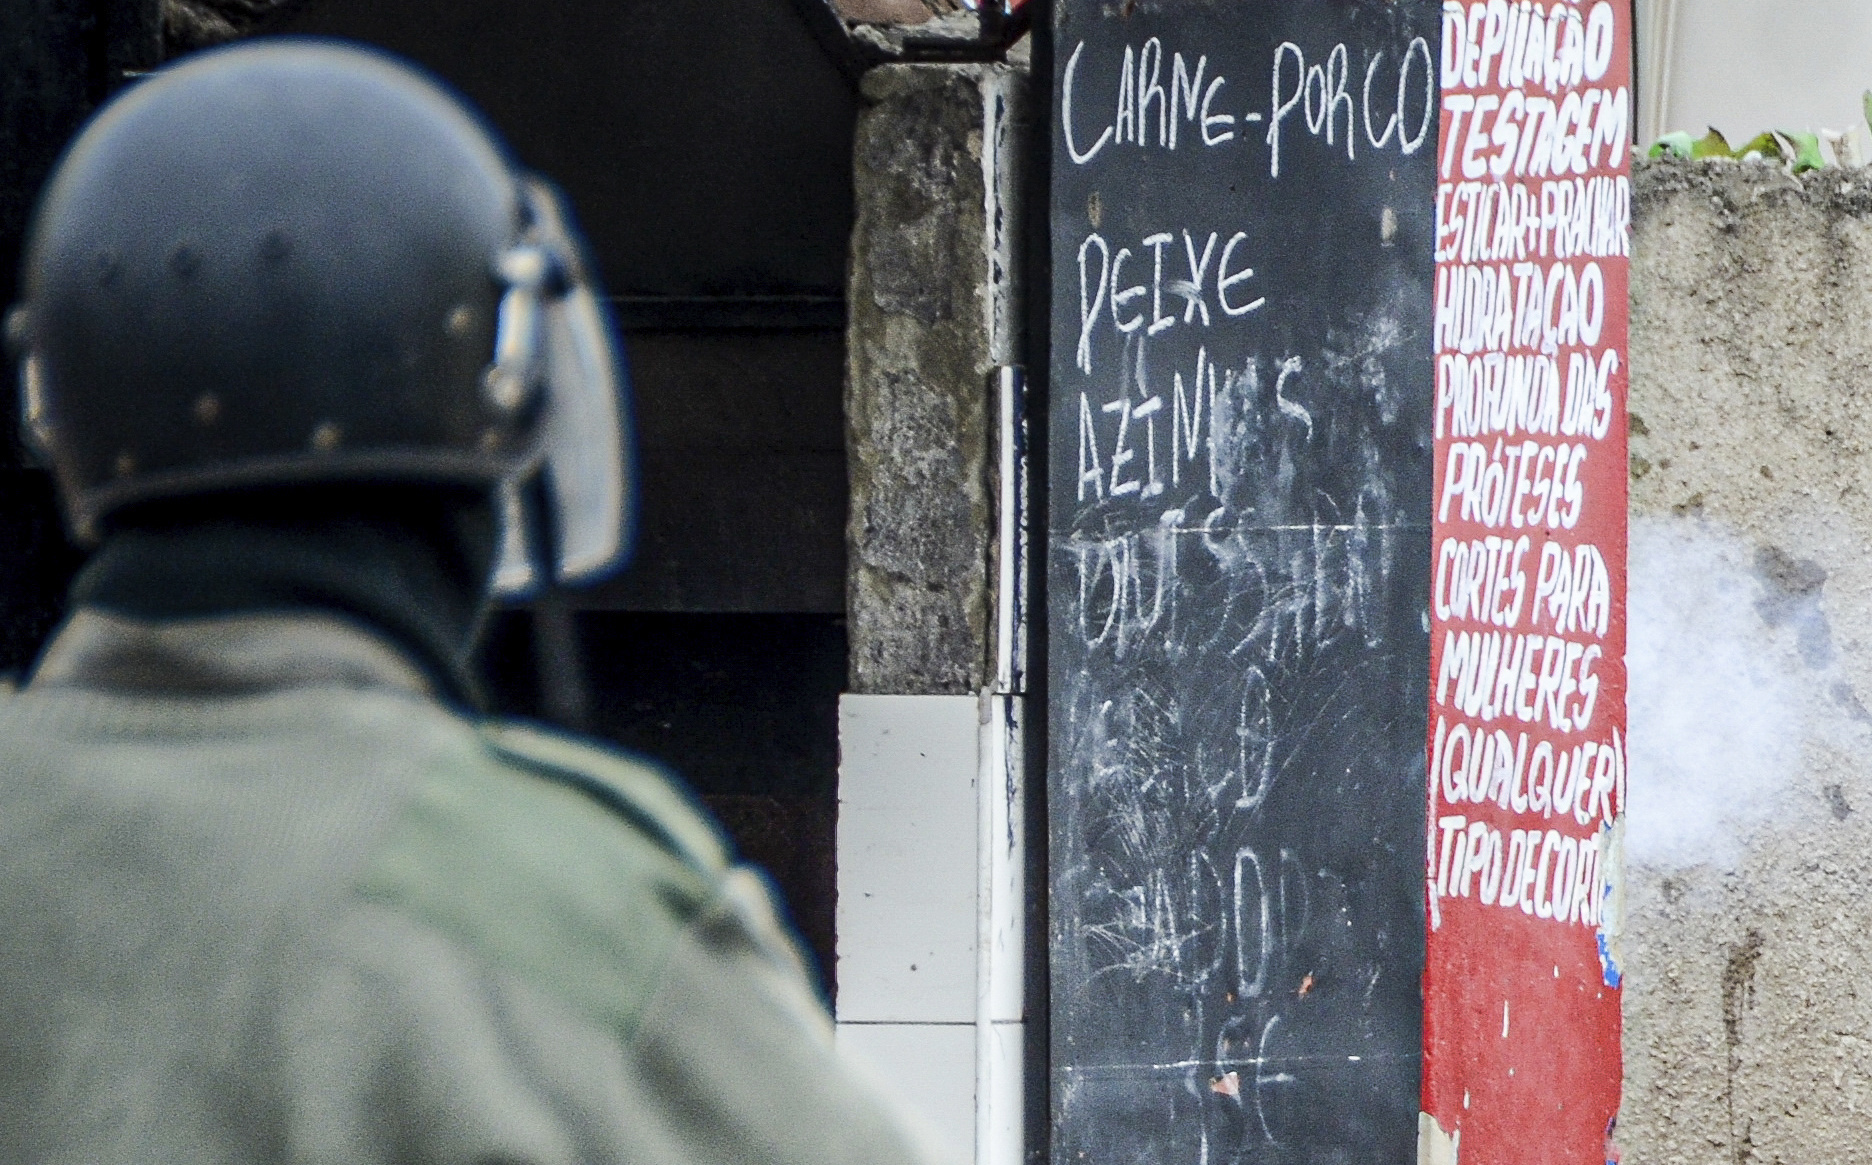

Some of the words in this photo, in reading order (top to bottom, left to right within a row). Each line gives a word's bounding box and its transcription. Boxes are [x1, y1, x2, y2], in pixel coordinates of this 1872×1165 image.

[1442, 86, 1629, 179] TESTAGEM
[1077, 227, 1266, 376] PEIXE
[1560, 348, 1619, 440] DAS
[1438, 437, 1587, 529] PRÓTESES
[1435, 535, 1530, 628] CORTES
[1531, 540, 1610, 638] PARA
[1435, 630, 1602, 734] MULHERES
